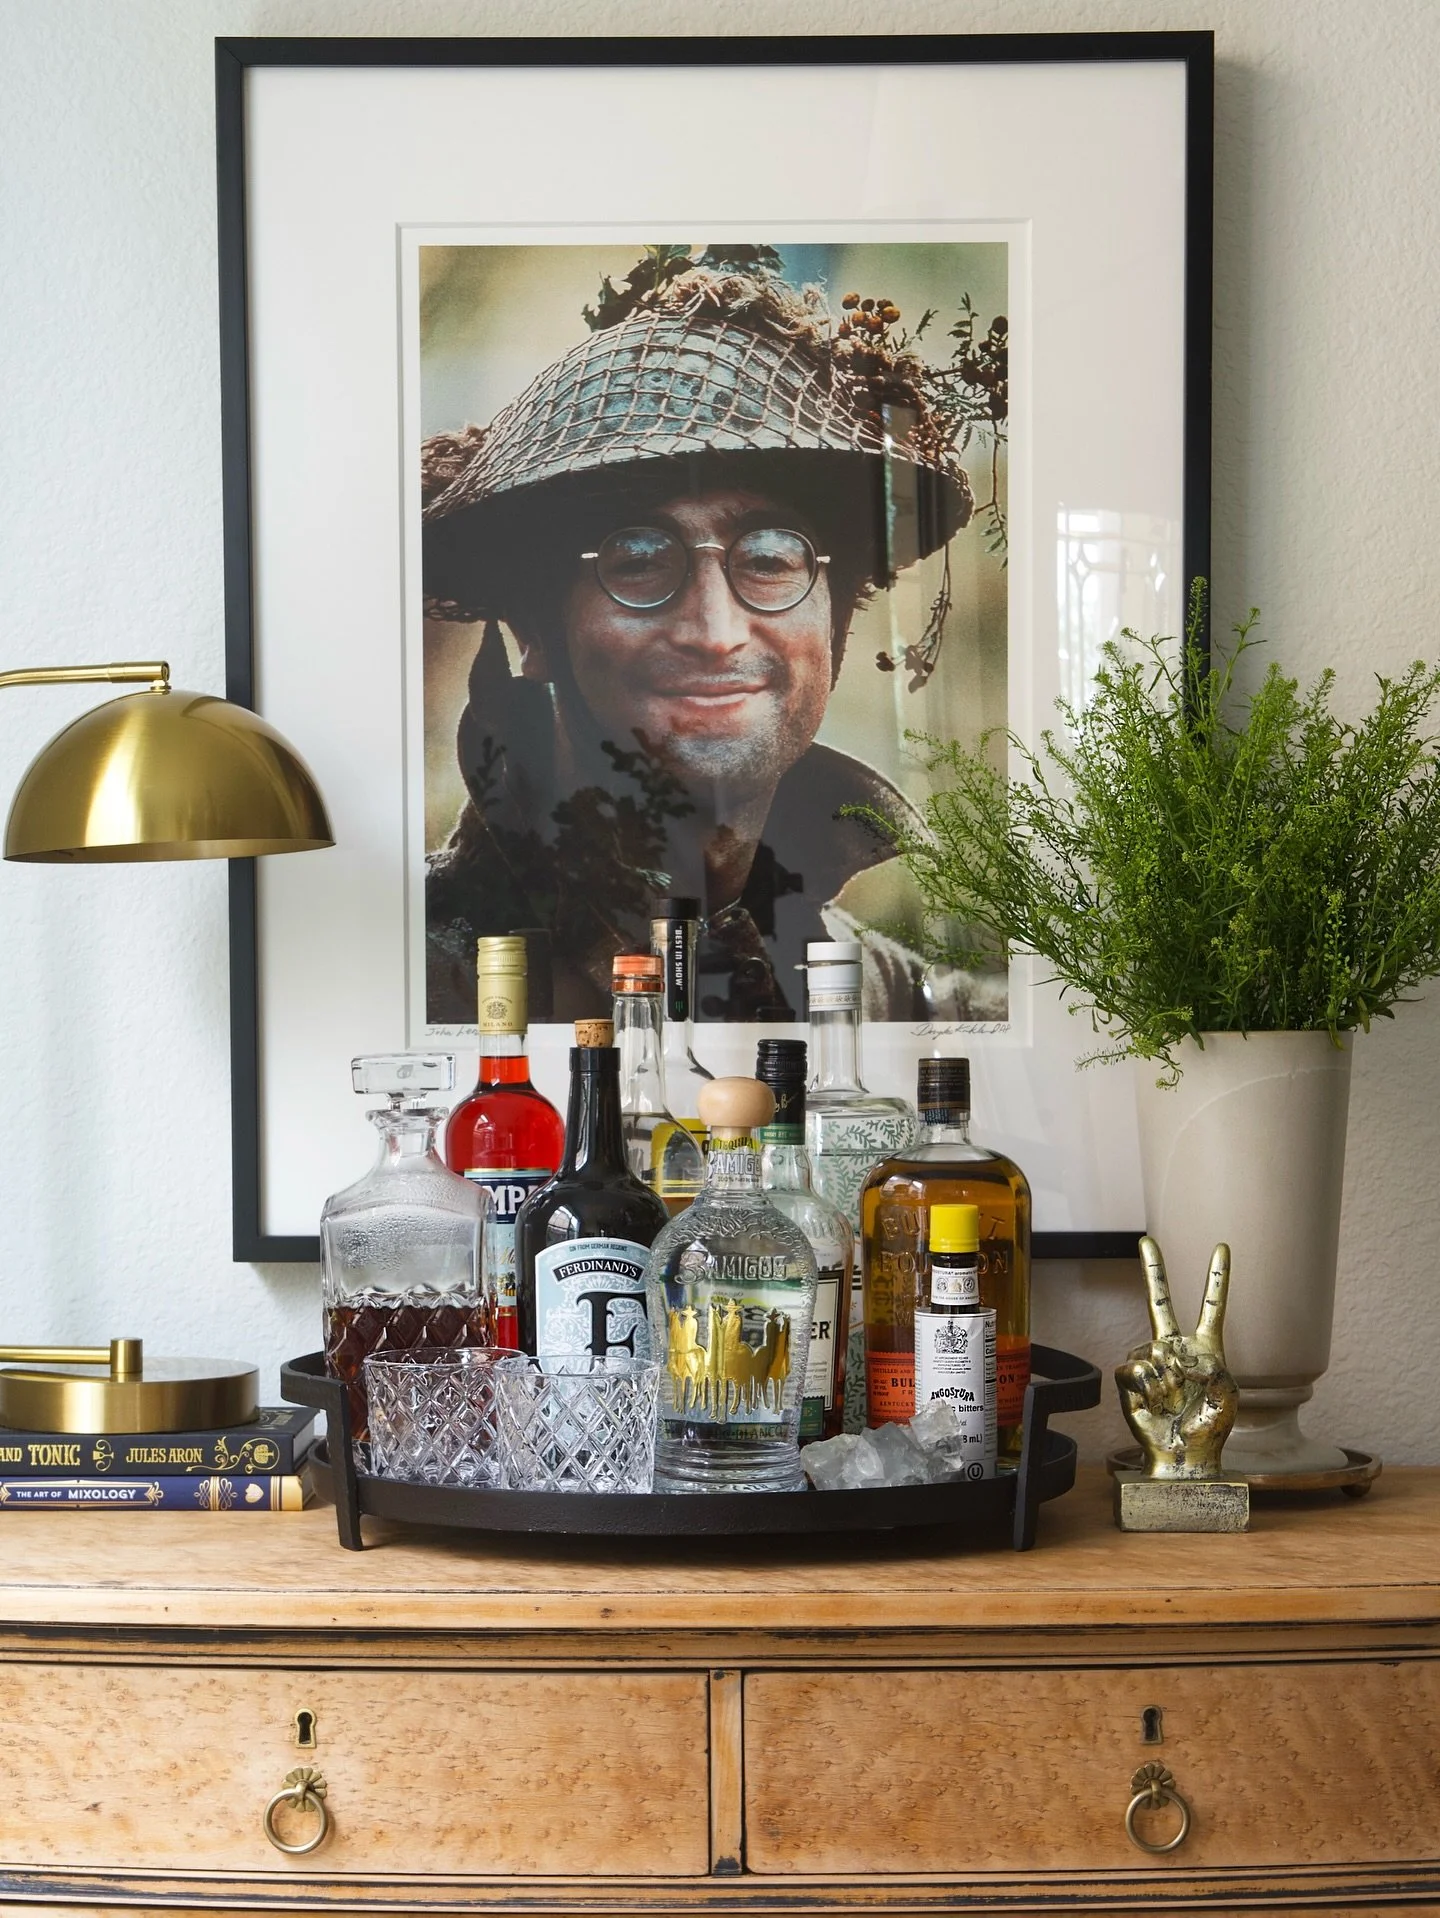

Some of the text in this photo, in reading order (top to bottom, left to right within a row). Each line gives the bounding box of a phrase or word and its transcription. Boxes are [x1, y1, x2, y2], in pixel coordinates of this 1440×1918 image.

[675, 951, 683, 960] IN
[456, 1025, 479, 1037] Len
[559, 1260, 638, 1278] FERDINAND'S
[930, 1386, 975, 1402] ANGOSTURA
[958, 1404, 984, 1413] bitters
[28, 1444, 81, 1466] TONIC
[126, 1447, 166, 1463] JULES
[168, 1447, 203, 1463] ARON
[68, 1489, 136, 1500] MIXOLOGY
